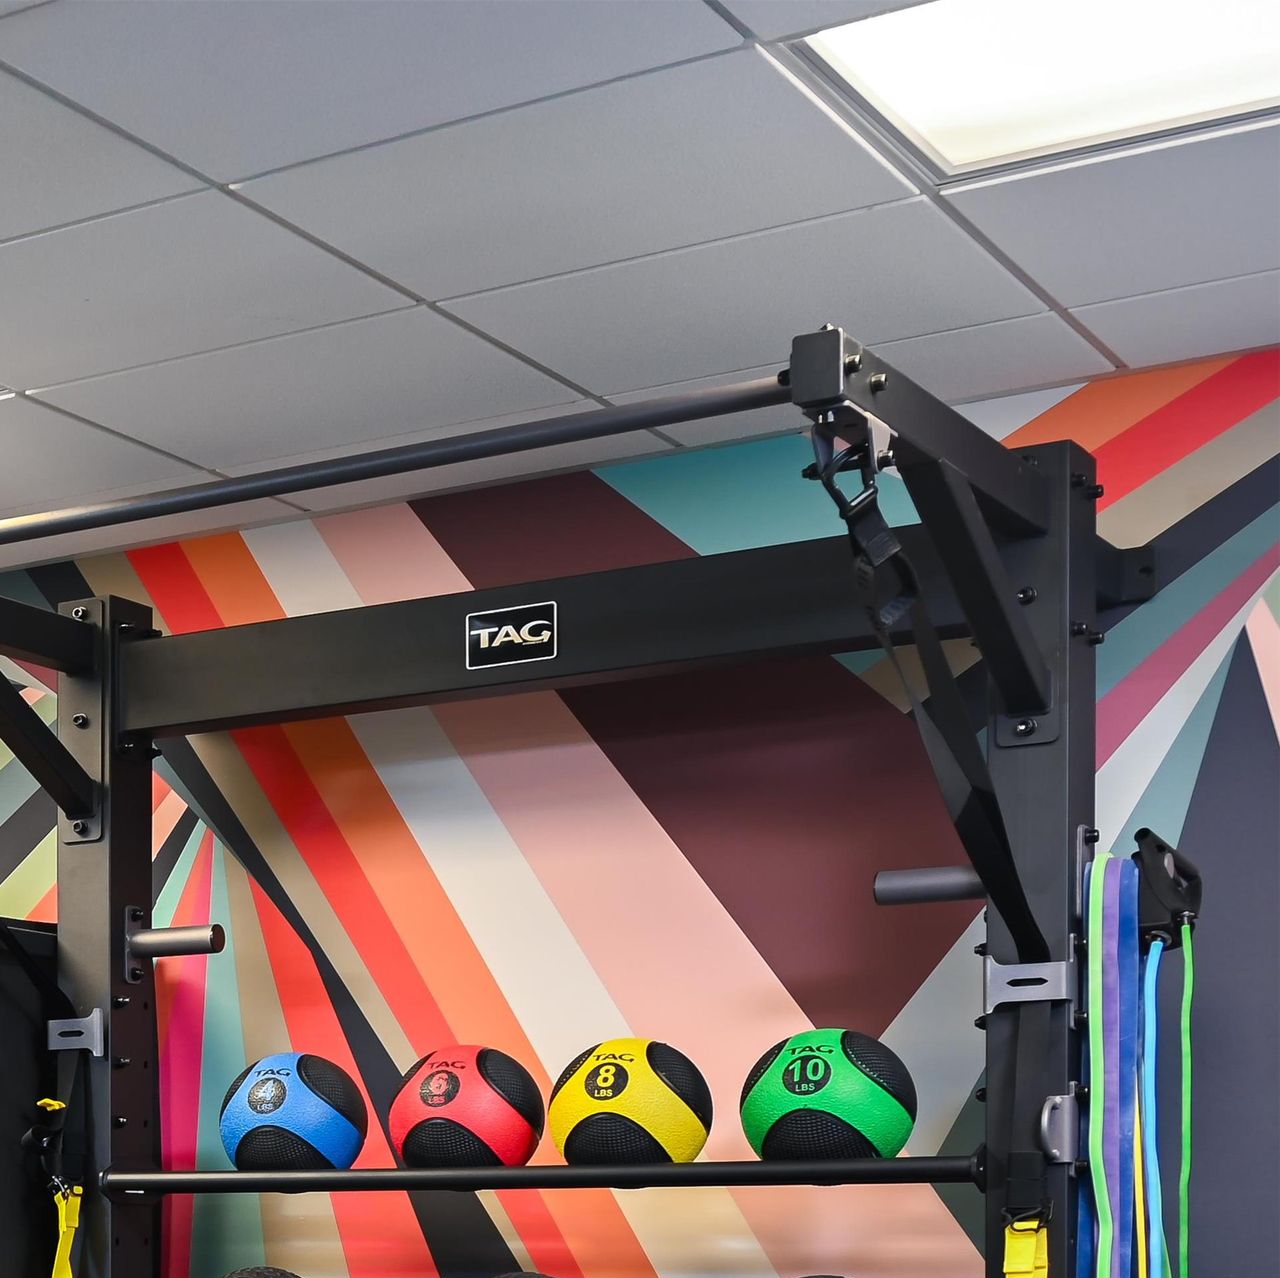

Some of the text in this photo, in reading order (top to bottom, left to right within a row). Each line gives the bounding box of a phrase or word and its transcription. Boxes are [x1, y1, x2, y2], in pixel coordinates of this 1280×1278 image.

[470, 620, 552, 649] TAG
[786, 1045, 835, 1056] TAG
[593, 1053, 635, 1063] TAG
[428, 1061, 466, 1070] TAG
[789, 1058, 826, 1082] 10
[254, 1068, 292, 1077] TAG
[596, 1065, 616, 1088] 8
[795, 1083, 815, 1092] LBS
[594, 1089, 613, 1098] LBS
